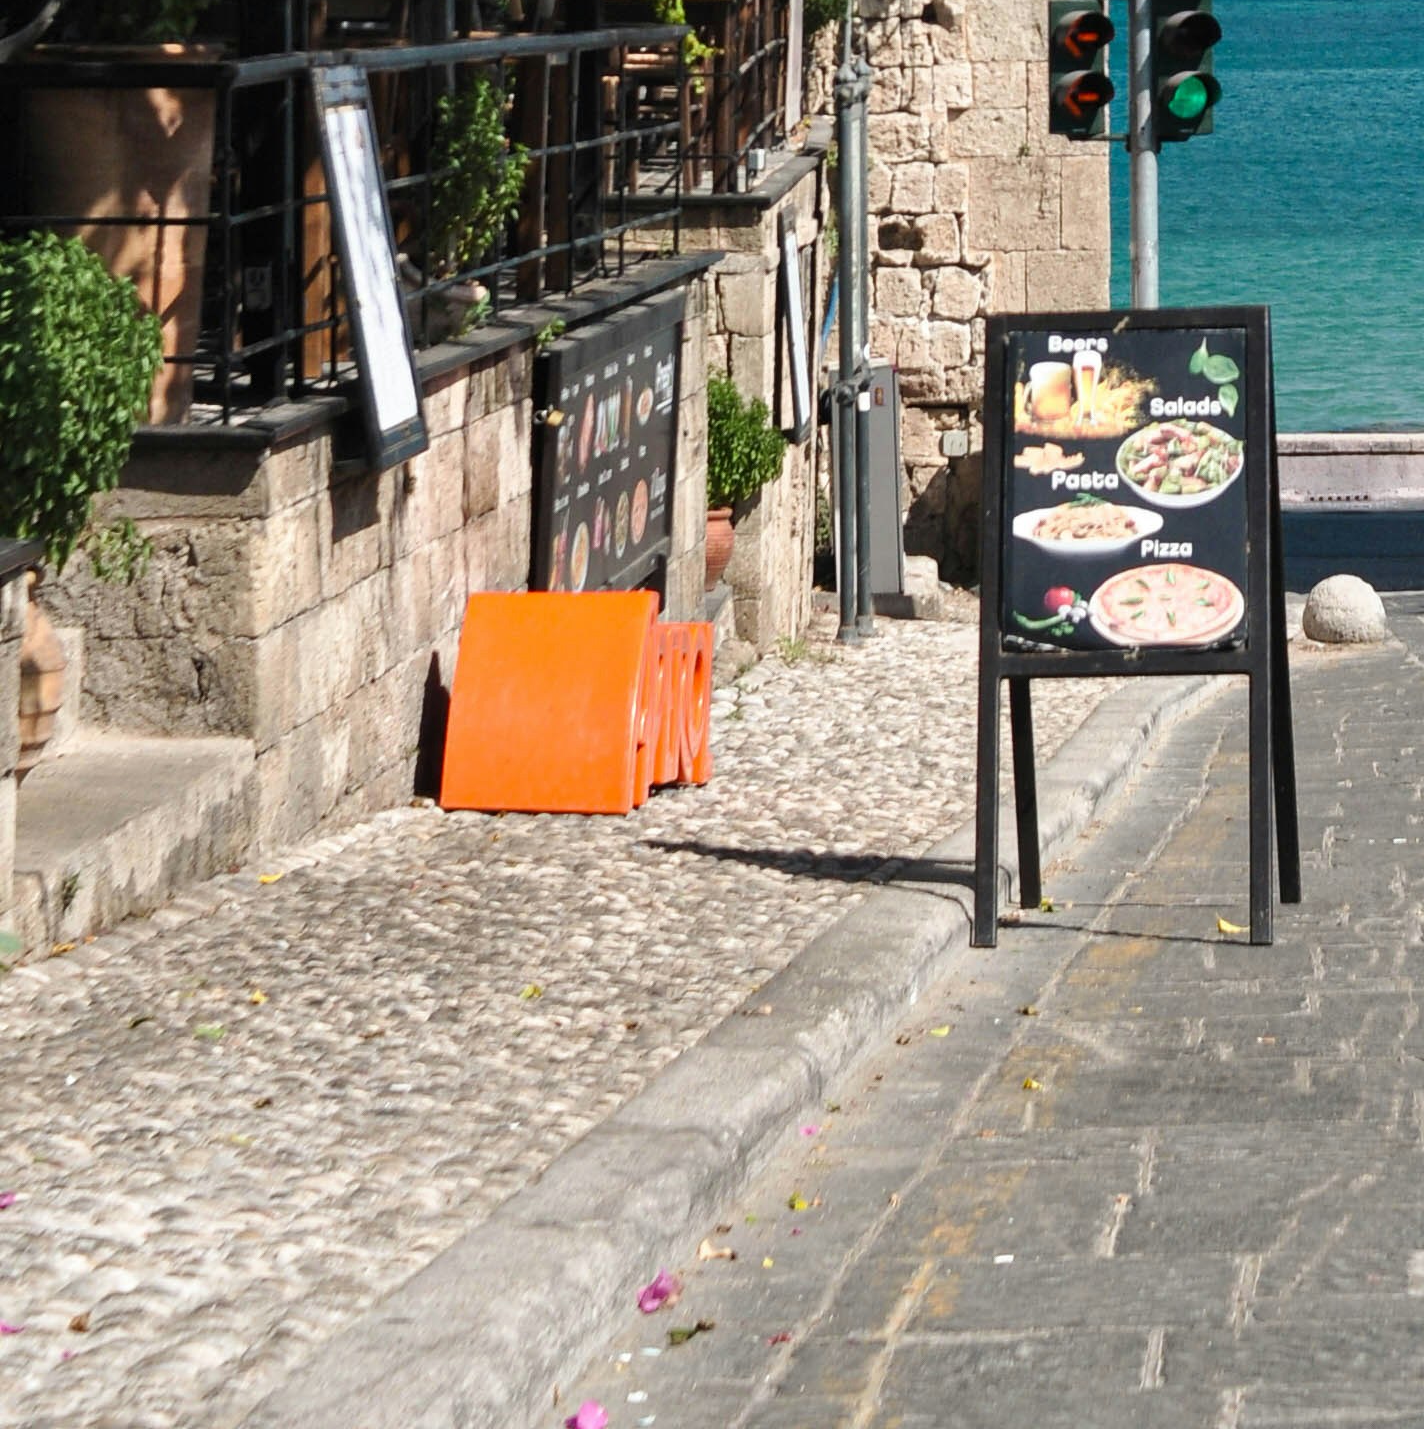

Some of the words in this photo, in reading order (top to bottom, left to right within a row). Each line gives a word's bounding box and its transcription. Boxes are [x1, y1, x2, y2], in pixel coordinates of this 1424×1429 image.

[1048, 335, 1108, 354] Beers
[1149, 397, 1222, 417] Salads
[1051, 471, 1119, 491] Pasta
[1140, 539, 1193, 558] Pizza
